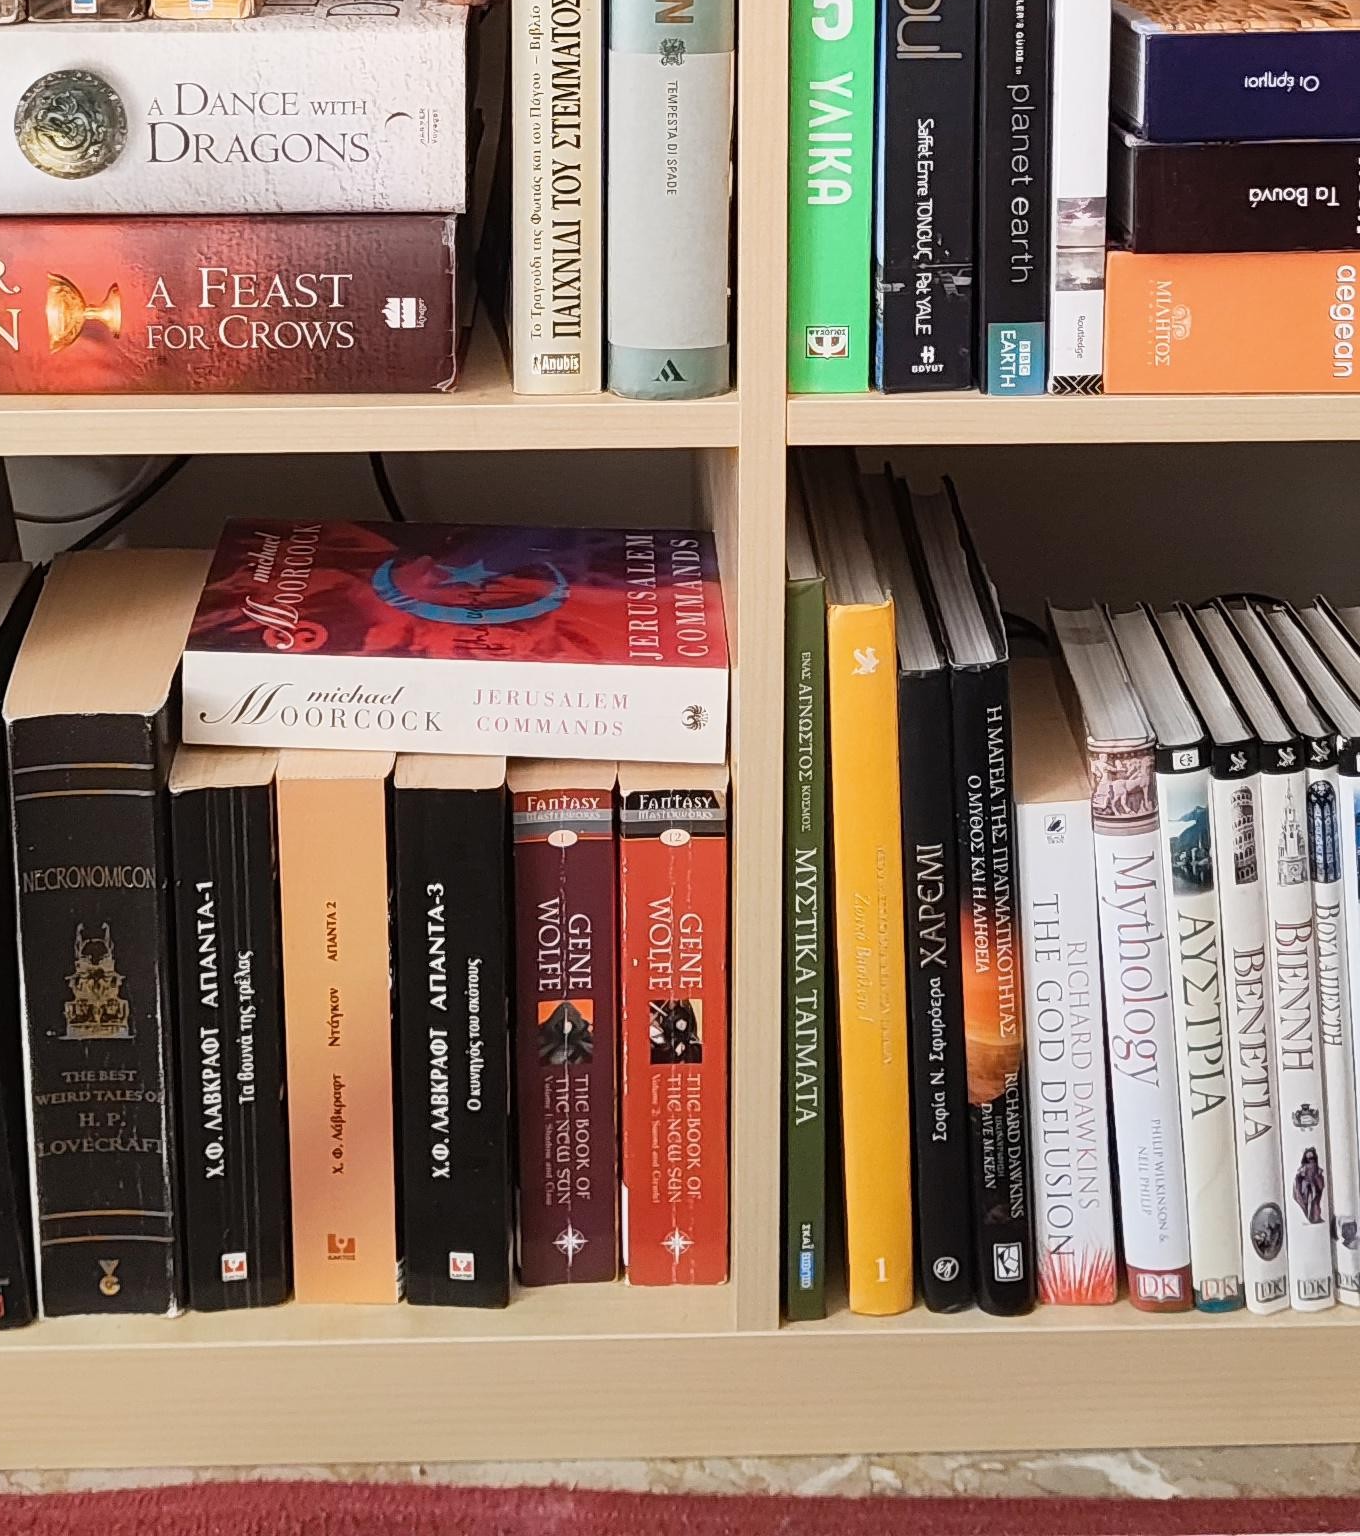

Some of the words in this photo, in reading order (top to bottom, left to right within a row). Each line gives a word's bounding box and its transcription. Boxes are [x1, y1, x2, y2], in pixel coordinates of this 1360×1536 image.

[174, 83, 300, 117] DANCE
[310, 99, 368, 116] WITH
[808, 71, 853, 207] ΥΛΙΚΑ
[917, 118, 935, 157] Saffet
[1007, 82, 1034, 187] planet
[146, 122, 371, 164] DRAGONS
[916, 161, 934, 197] Emre
[553, 156, 582, 212] ΤΟΥ
[552, 219, 583, 338] ΠΑΙΧΝΙΔΙ
[1008, 195, 1034, 285] earth
[146, 275, 174, 309] A
[198, 267, 354, 310] FEAST
[914, 272, 932, 296] Pat
[914, 297, 932, 337] YALE
[1330, 265, 1357, 378] aegean
[146, 323, 204, 350] FOR
[218, 315, 355, 350] CROWS
[999, 330, 1017, 389] EARTH
[198, 681, 443, 734] MOORCOCK
[305, 686, 405, 706] michael
[473, 689, 629, 711] JERUSALEM
[475, 715, 625, 736] COMMANDS
[23, 865, 156, 893] NECRONOMICON
[537, 896, 561, 991] WOLFE
[568, 913, 593, 991] GENE
[794, 847, 818, 992] ΜΥΣΤΙΚΑ
[1032, 893, 1062, 964] THE
[1065, 940, 1092, 1071] RICHARD
[1101, 850, 1169, 1089] Mythology
[1275, 919, 1314, 1072] ΒΙΕΝΝΗ
[1036, 980, 1066, 1063] GOD
[1178, 910, 1227, 1120] ΑΥΣΤΡΙΑ
[1233, 943, 1273, 1144] ΒΕΝΕΤΙΑ
[200, 1026, 222, 1131] ΛΑΒΚΡΑΦΤ
[795, 995, 823, 1126] ΤΑΓΜΑΤΑ
[1040, 1080, 1075, 1258] DELUSION
[1072, 1080, 1100, 1210] DAWKINS
